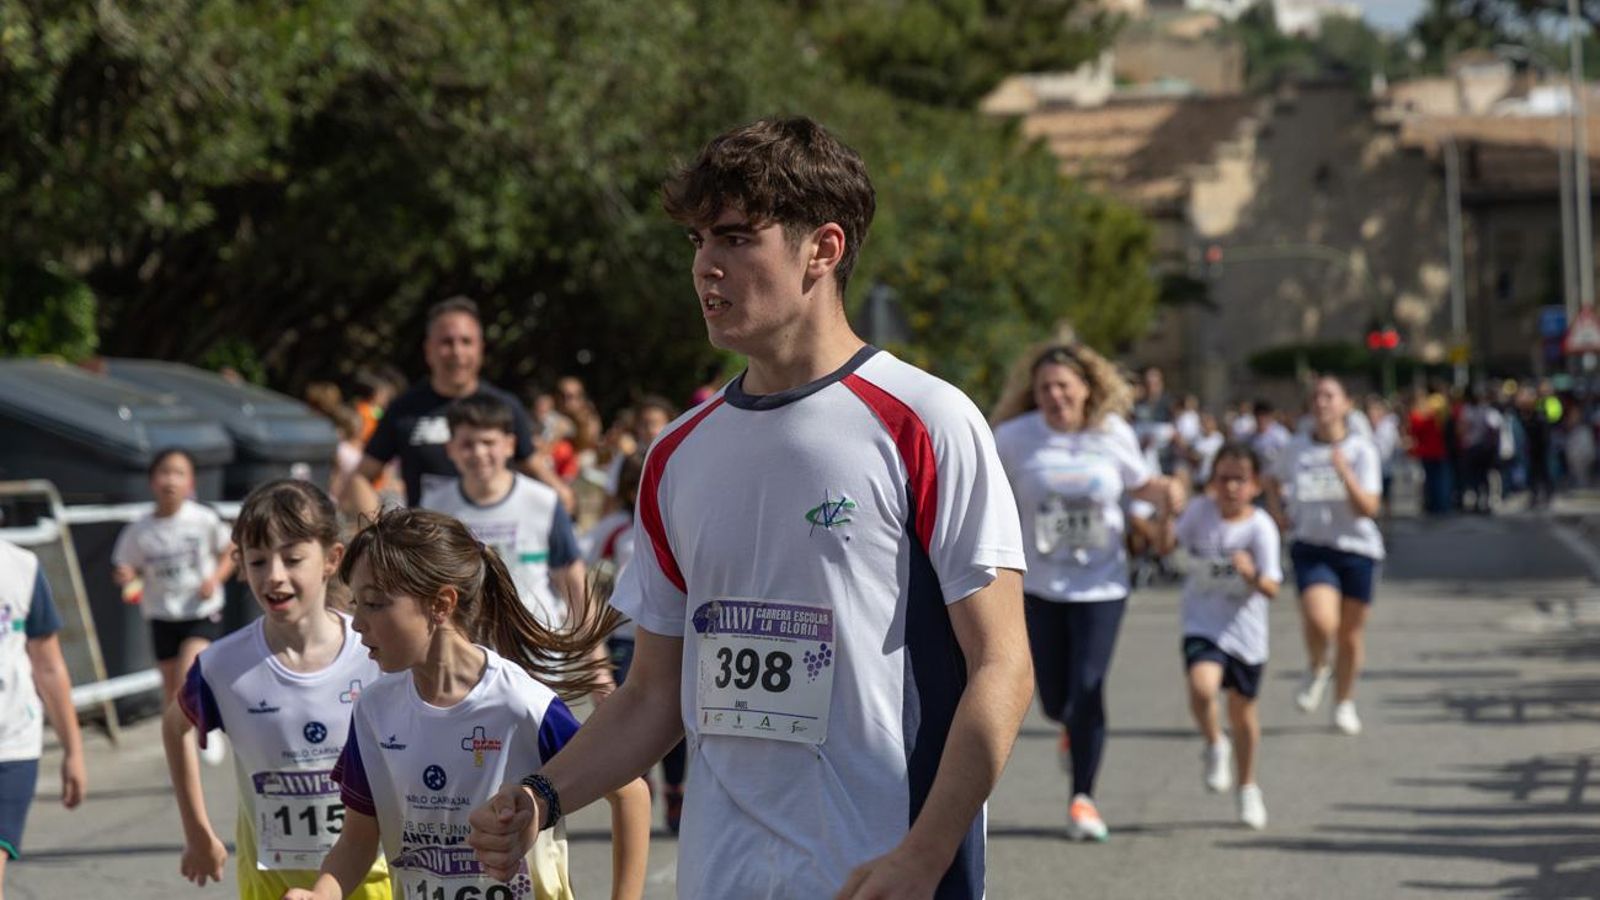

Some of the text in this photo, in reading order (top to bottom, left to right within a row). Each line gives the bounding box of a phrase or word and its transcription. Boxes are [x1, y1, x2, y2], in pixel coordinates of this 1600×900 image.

[756, 608, 829, 625] CARRERA ESCOLAR
[760, 619, 818, 637] LA GLORIA
[715, 647, 793, 693] 398
[274, 804, 345, 836] 115
[418, 822, 436, 834] DE
[402, 832, 441, 846] ANTA
